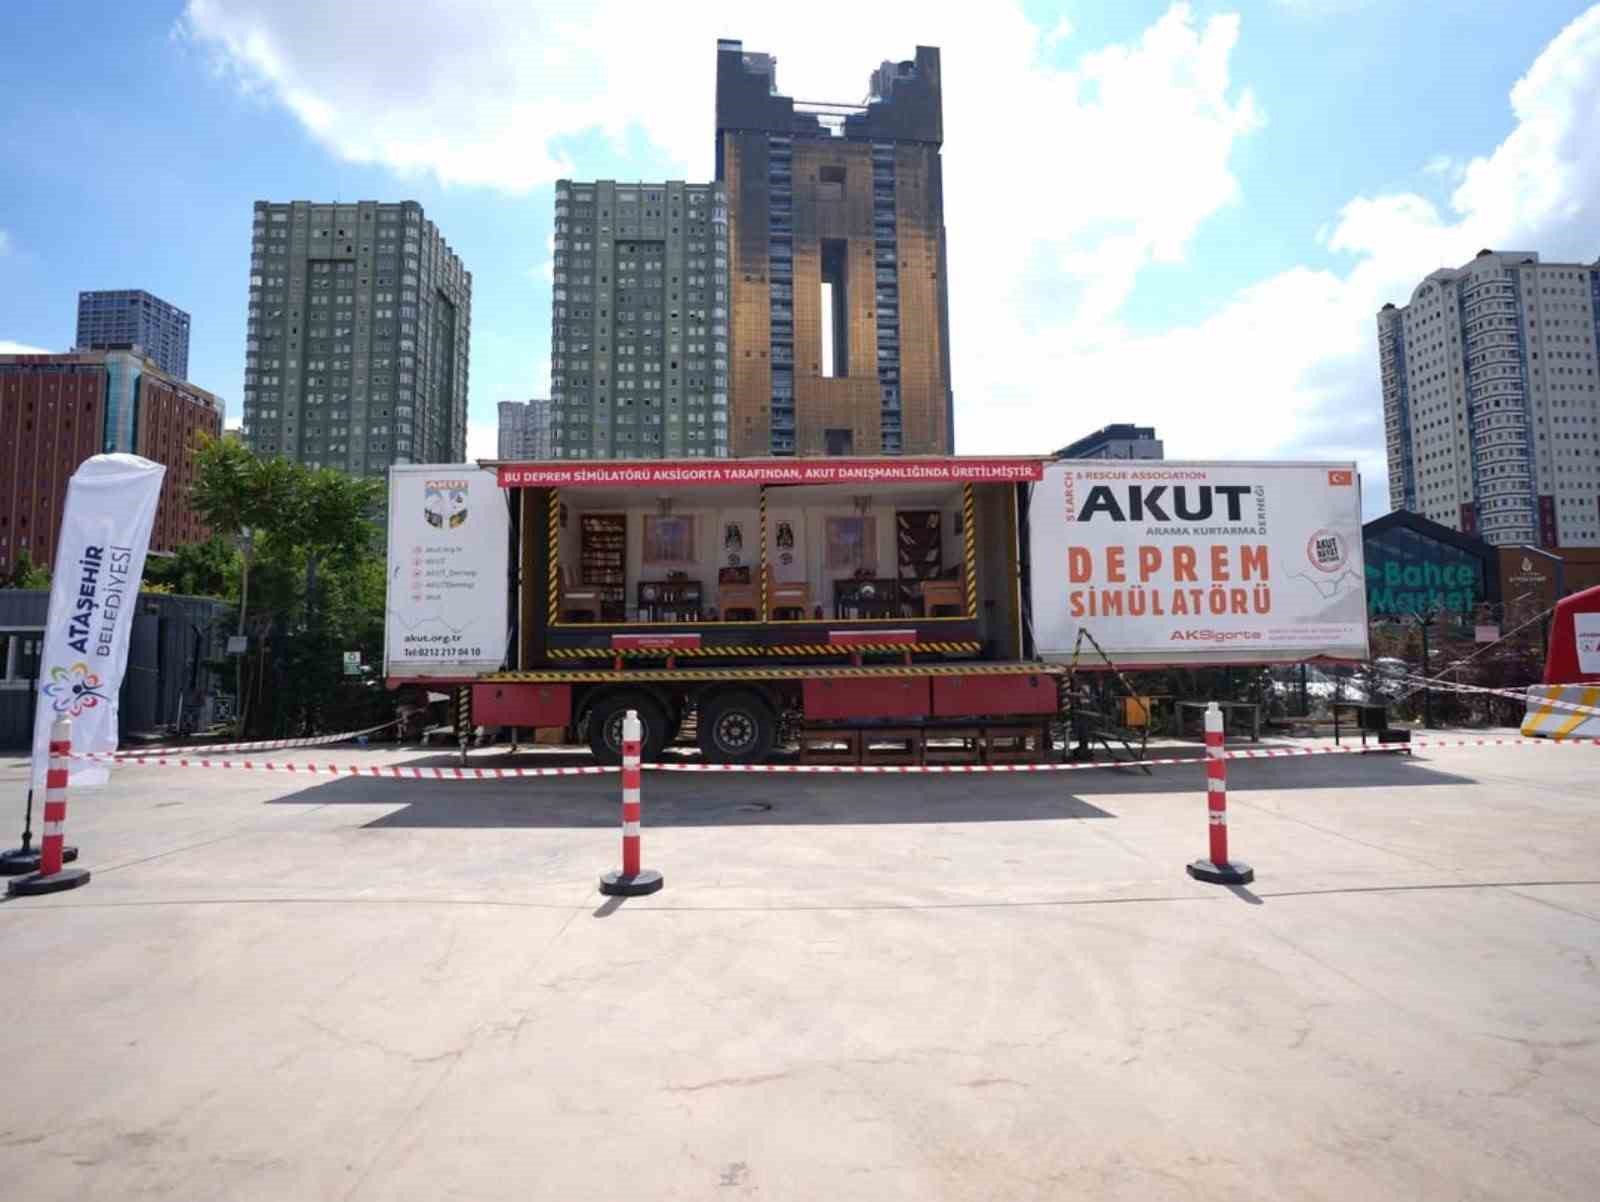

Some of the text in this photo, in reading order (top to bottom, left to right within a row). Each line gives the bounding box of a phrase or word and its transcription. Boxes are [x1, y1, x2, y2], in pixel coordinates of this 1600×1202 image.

[504, 471, 521, 482] BU
[524, 471, 571, 481] DEPREM
[573, 468, 651, 481] SİMÜLATÖRÜ
[653, 468, 721, 481] AKSİGORTA
[805, 468, 835, 479] AKUT
[838, 465, 949, 480] DANIŞMANLIĞINDA
[1085, 472, 1127, 480] RESCUE
[1131, 471, 1207, 480] ASSOCIATION
[1065, 471, 1074, 521] SEARCH
[1077, 485, 1252, 522] AKUT
[1258, 484, 1267, 535] DERNEĞİ
[1146, 527, 1257, 536] ARAMA KURTARMA
[1067, 544, 1270, 583] DEPREM
[67, 545, 104, 654] ATAŞEHİR
[96, 545, 133, 657] BELEDİYESİ
[1069, 584, 1272, 617] SİMÜLATÖRÜ
[404, 633, 462, 644] akut.org.tr
[441, 647, 456, 656] 217
[471, 647, 481, 656] 10
